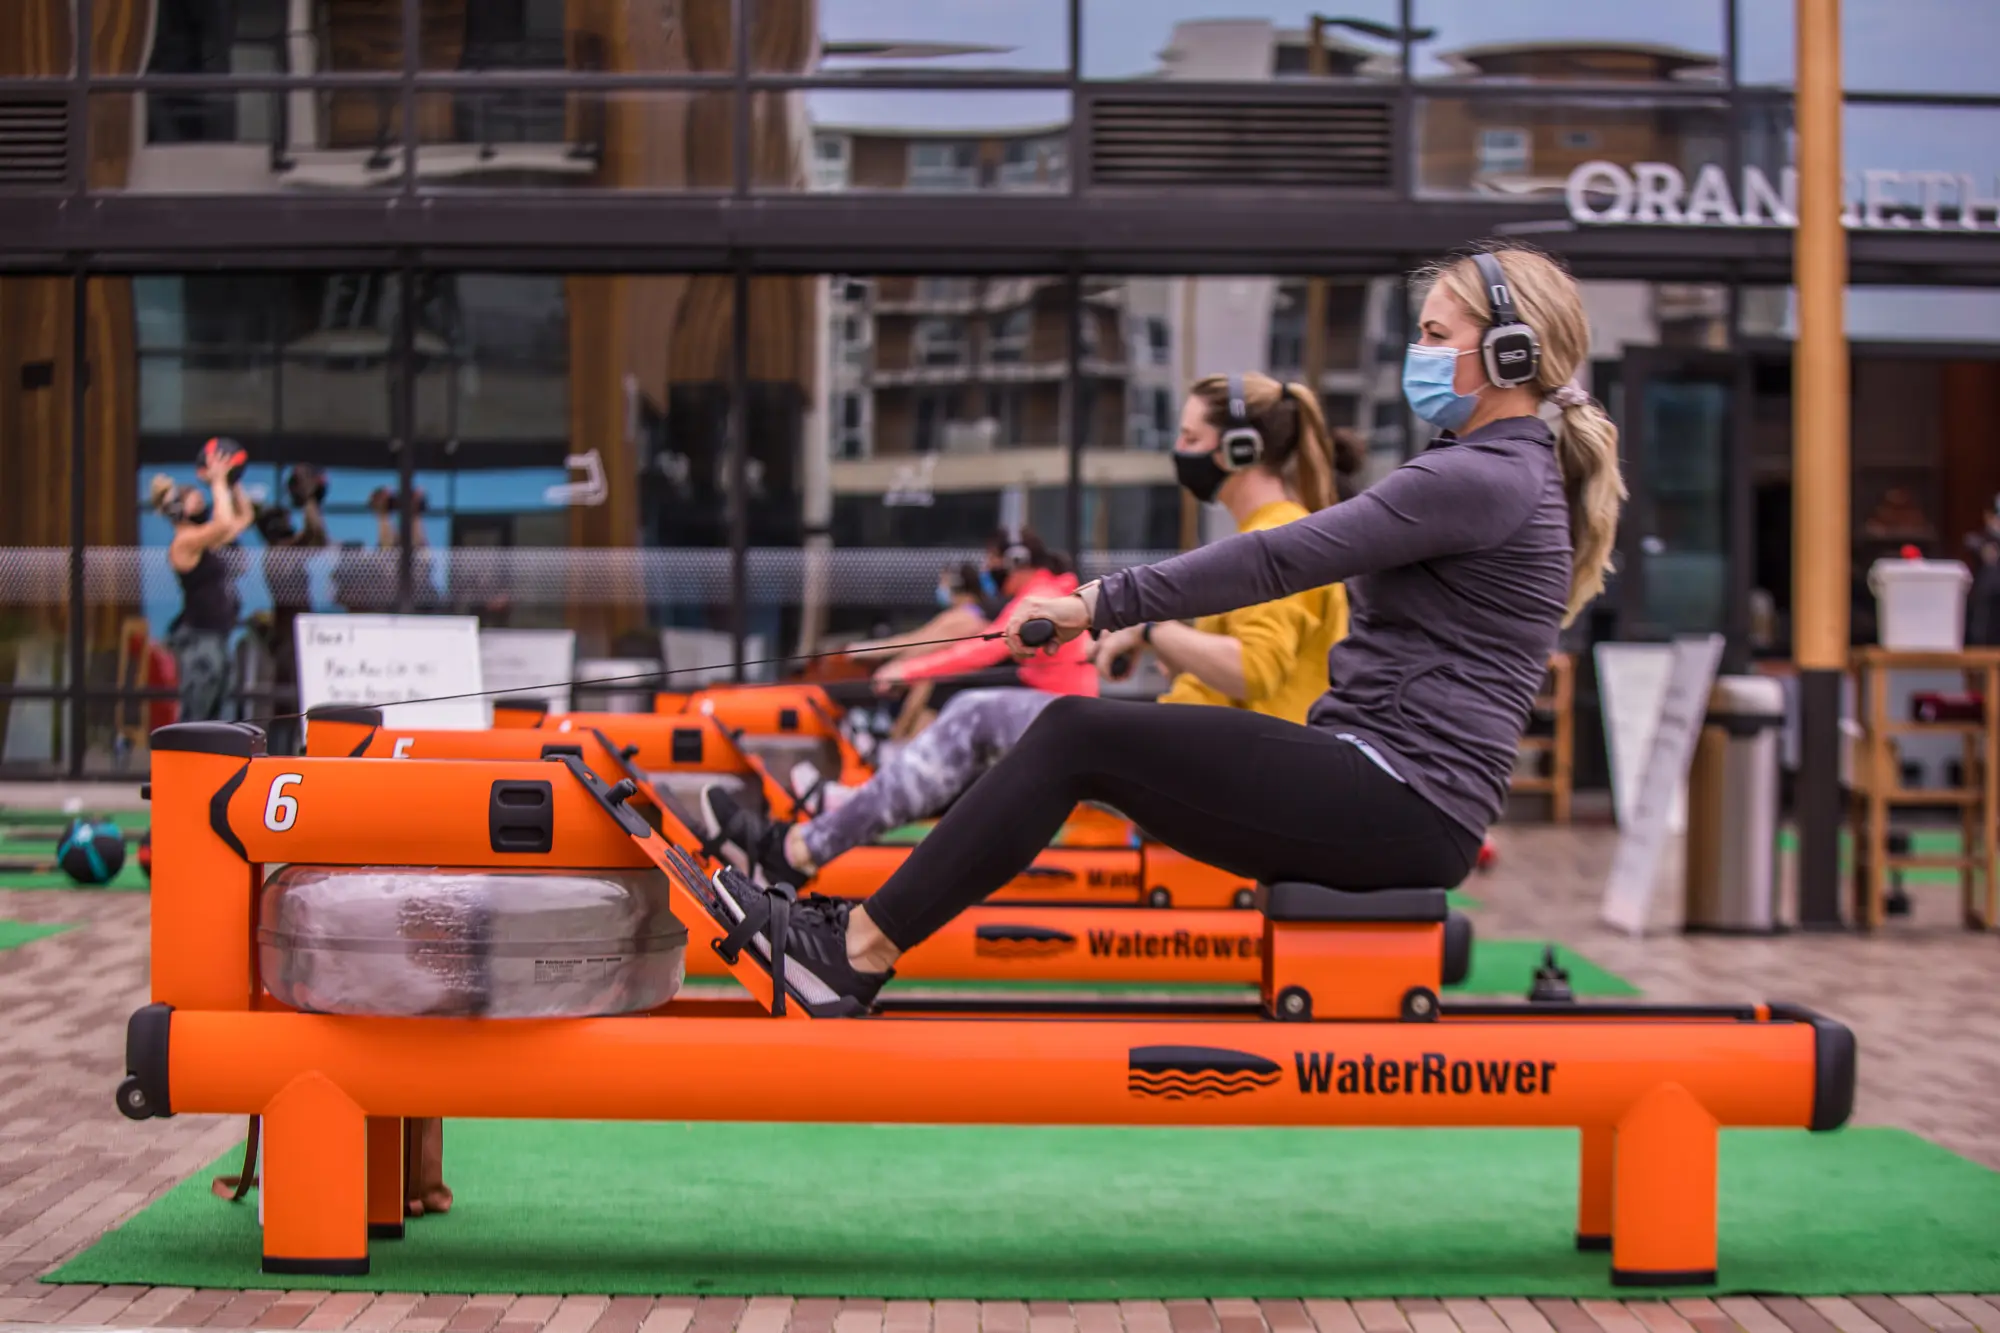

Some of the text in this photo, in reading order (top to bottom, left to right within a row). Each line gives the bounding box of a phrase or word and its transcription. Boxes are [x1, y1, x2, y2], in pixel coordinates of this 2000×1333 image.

[1566, 160, 2000, 230] ORANETH
[263, 772, 304, 832] 6
[1294, 1051, 1557, 1095] WaterRower
